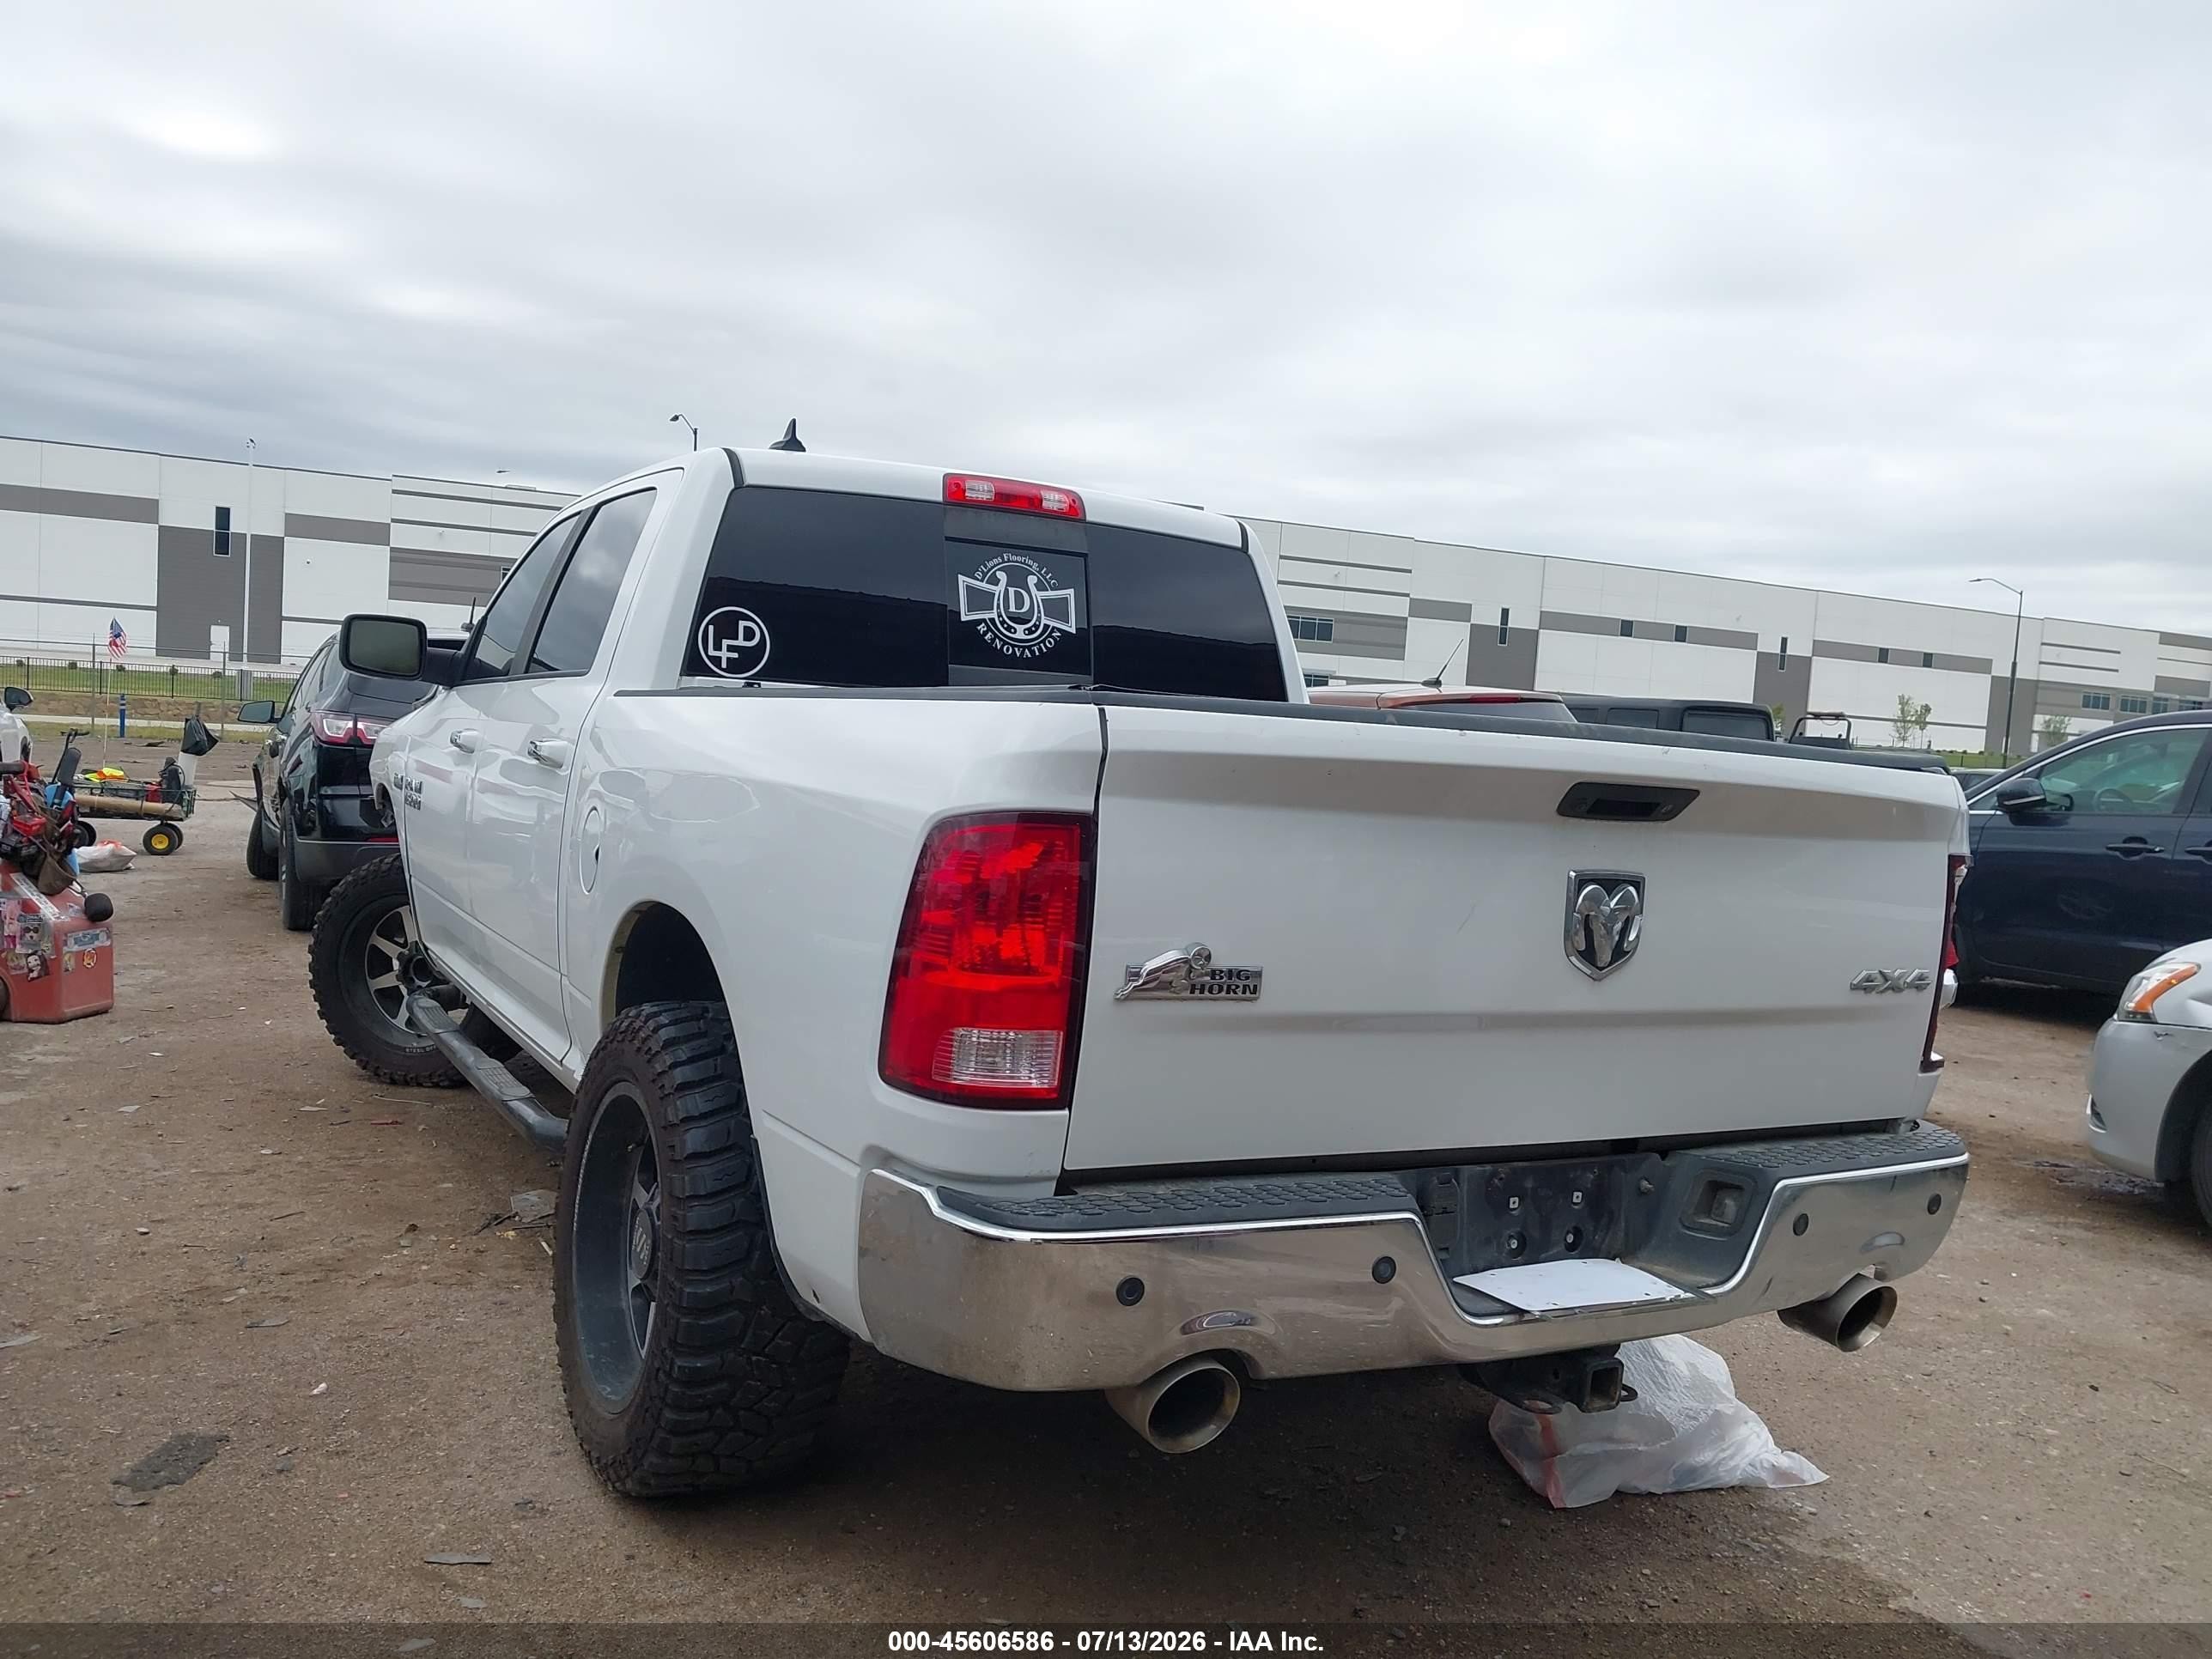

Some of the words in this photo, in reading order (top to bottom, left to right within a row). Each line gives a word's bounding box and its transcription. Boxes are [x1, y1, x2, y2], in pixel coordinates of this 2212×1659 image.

[1003, 553, 1040, 572] Flooring,
[1041, 568, 1059, 588] LLC
[1006, 587, 1030, 612] D
[976, 623, 1062, 658] RENOVATION
[1210, 969, 1251, 981] BIG
[1850, 969, 1932, 993] 4X4
[1188, 984, 1257, 995] HORN
